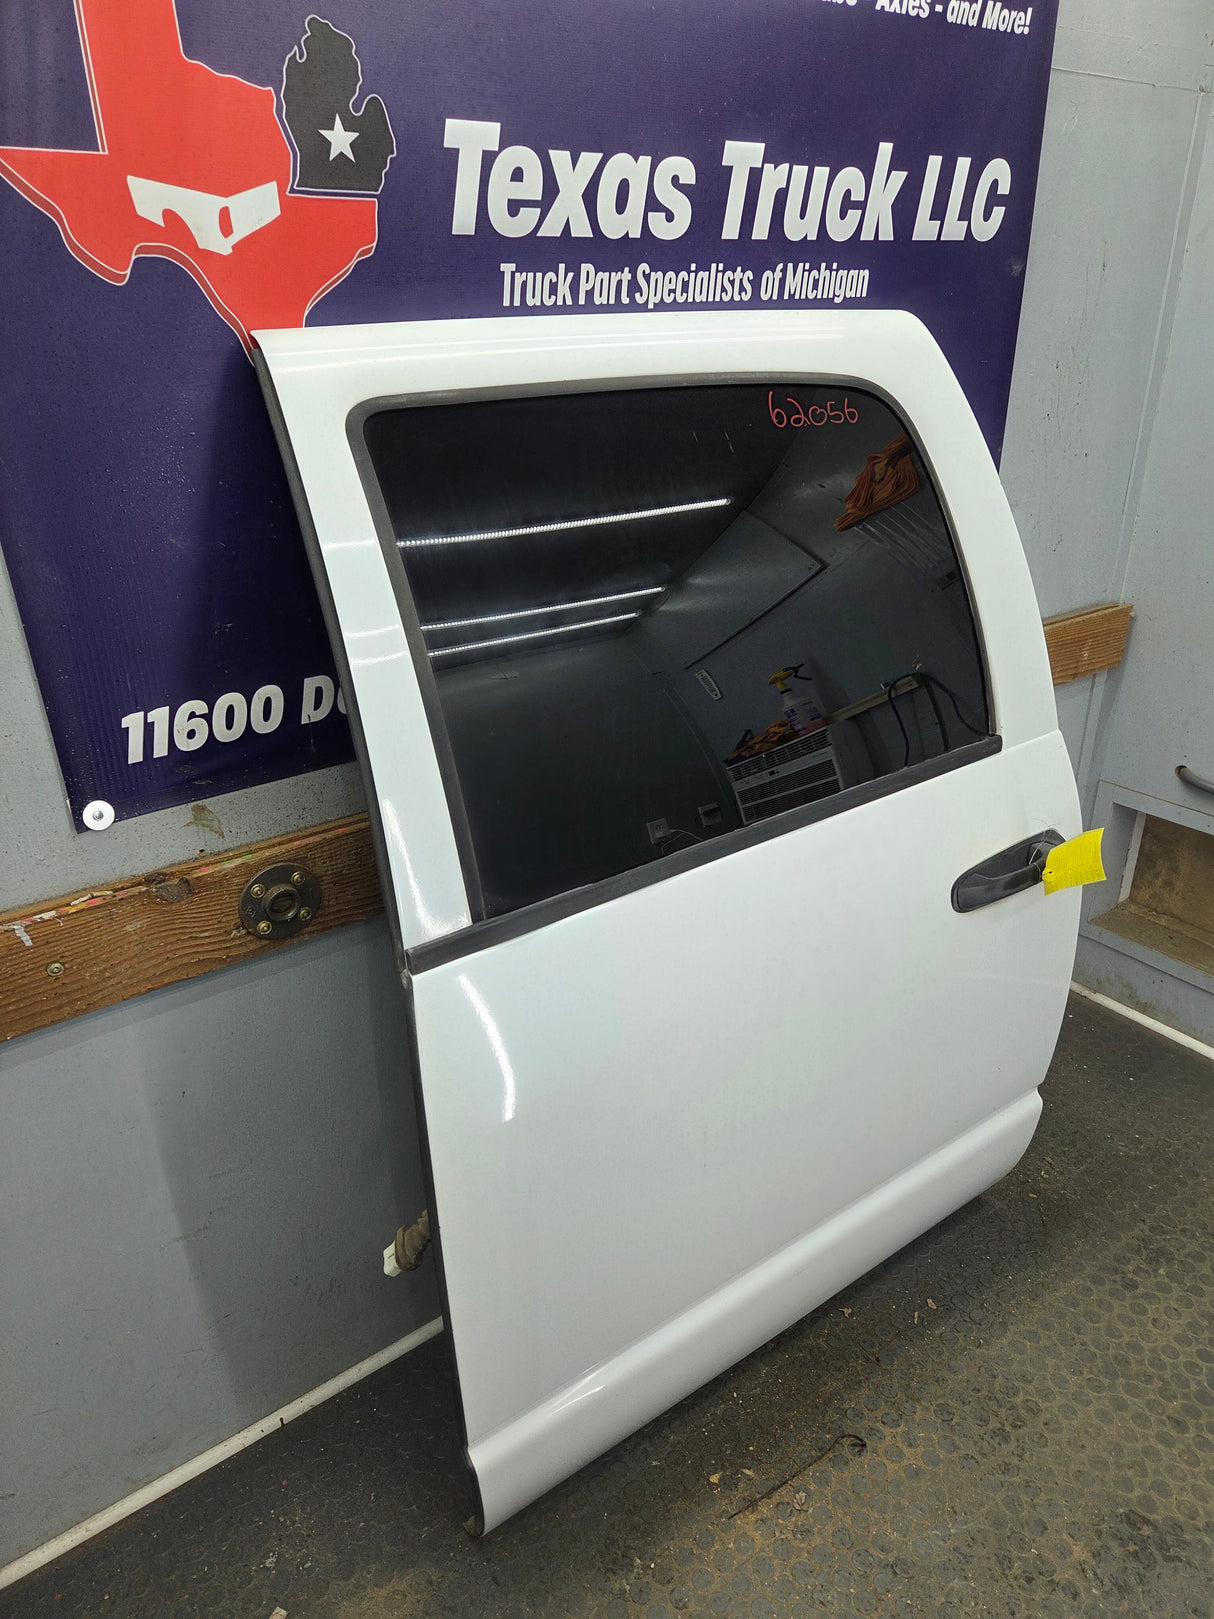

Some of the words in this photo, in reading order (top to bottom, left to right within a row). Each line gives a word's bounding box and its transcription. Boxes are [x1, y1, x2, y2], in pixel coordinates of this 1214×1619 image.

[946, 0, 983, 27] and
[981, 0, 1033, 35] More!
[444, 118, 697, 240] Texas
[721, 140, 909, 241] Truck
[911, 155, 1012, 242] LLC
[499, 262, 575, 307] Truck
[578, 263, 632, 306] Part
[634, 262, 754, 309] Specialists
[759, 262, 784, 301] of
[783, 262, 870, 304] Michigan
[768, 391, 859, 428] 62056
[120, 684, 285, 765] 11600
